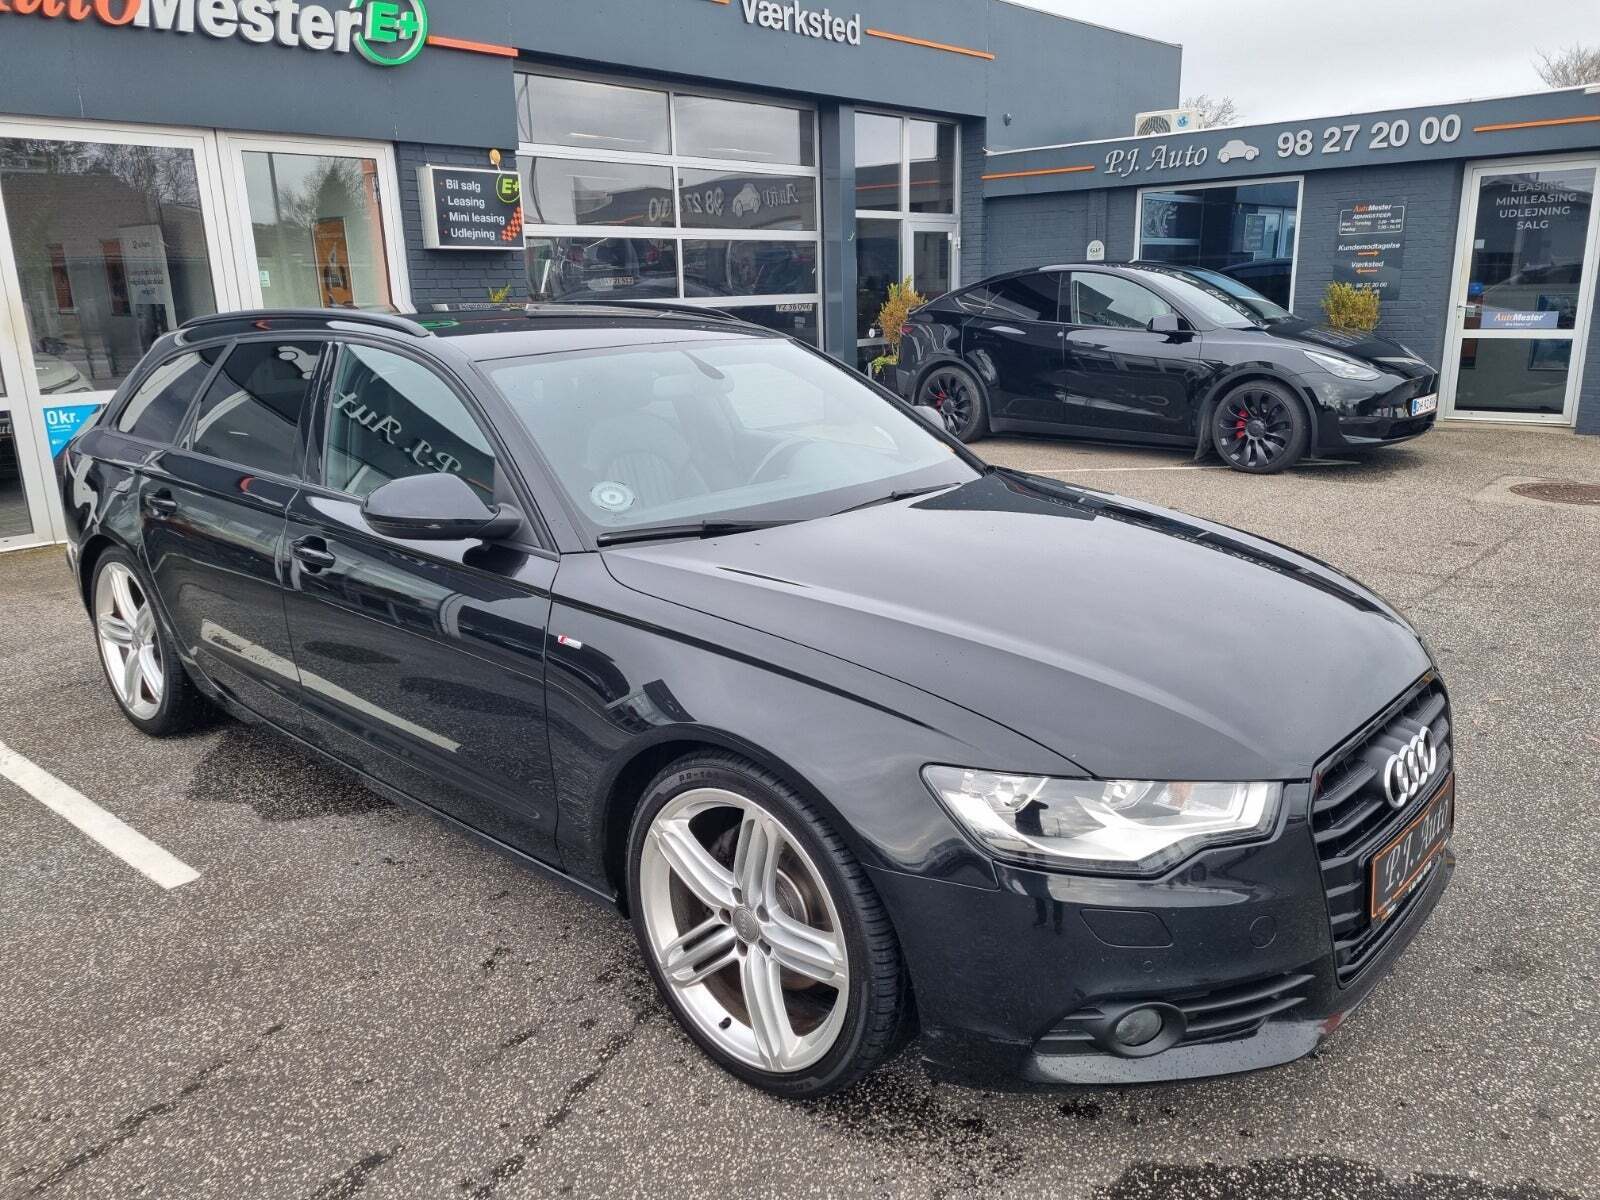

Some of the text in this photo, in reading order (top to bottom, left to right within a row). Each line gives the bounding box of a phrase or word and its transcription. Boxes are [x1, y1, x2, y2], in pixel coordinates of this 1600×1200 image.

[741, 0, 860, 46] Værksted
[1104, 113, 1462, 177] P.J. Auto 98 27 20 00
[445, 179, 481, 193] Bil salg
[1511, 181, 1566, 193] LEASING
[447, 195, 486, 209] Leasing
[1496, 193, 1577, 206] MINILEASING
[448, 211, 505, 225] Mini leasing
[1499, 206, 1571, 218] UDLEJNING
[1516, 220, 1549, 231] SALG
[450, 227, 496, 240] Udlejning
[1338, 242, 1401, 251] Kundemodtagelse
[46, 409, 81, 425] 0 kr.
[1416, 801, 1449, 861] Auto
